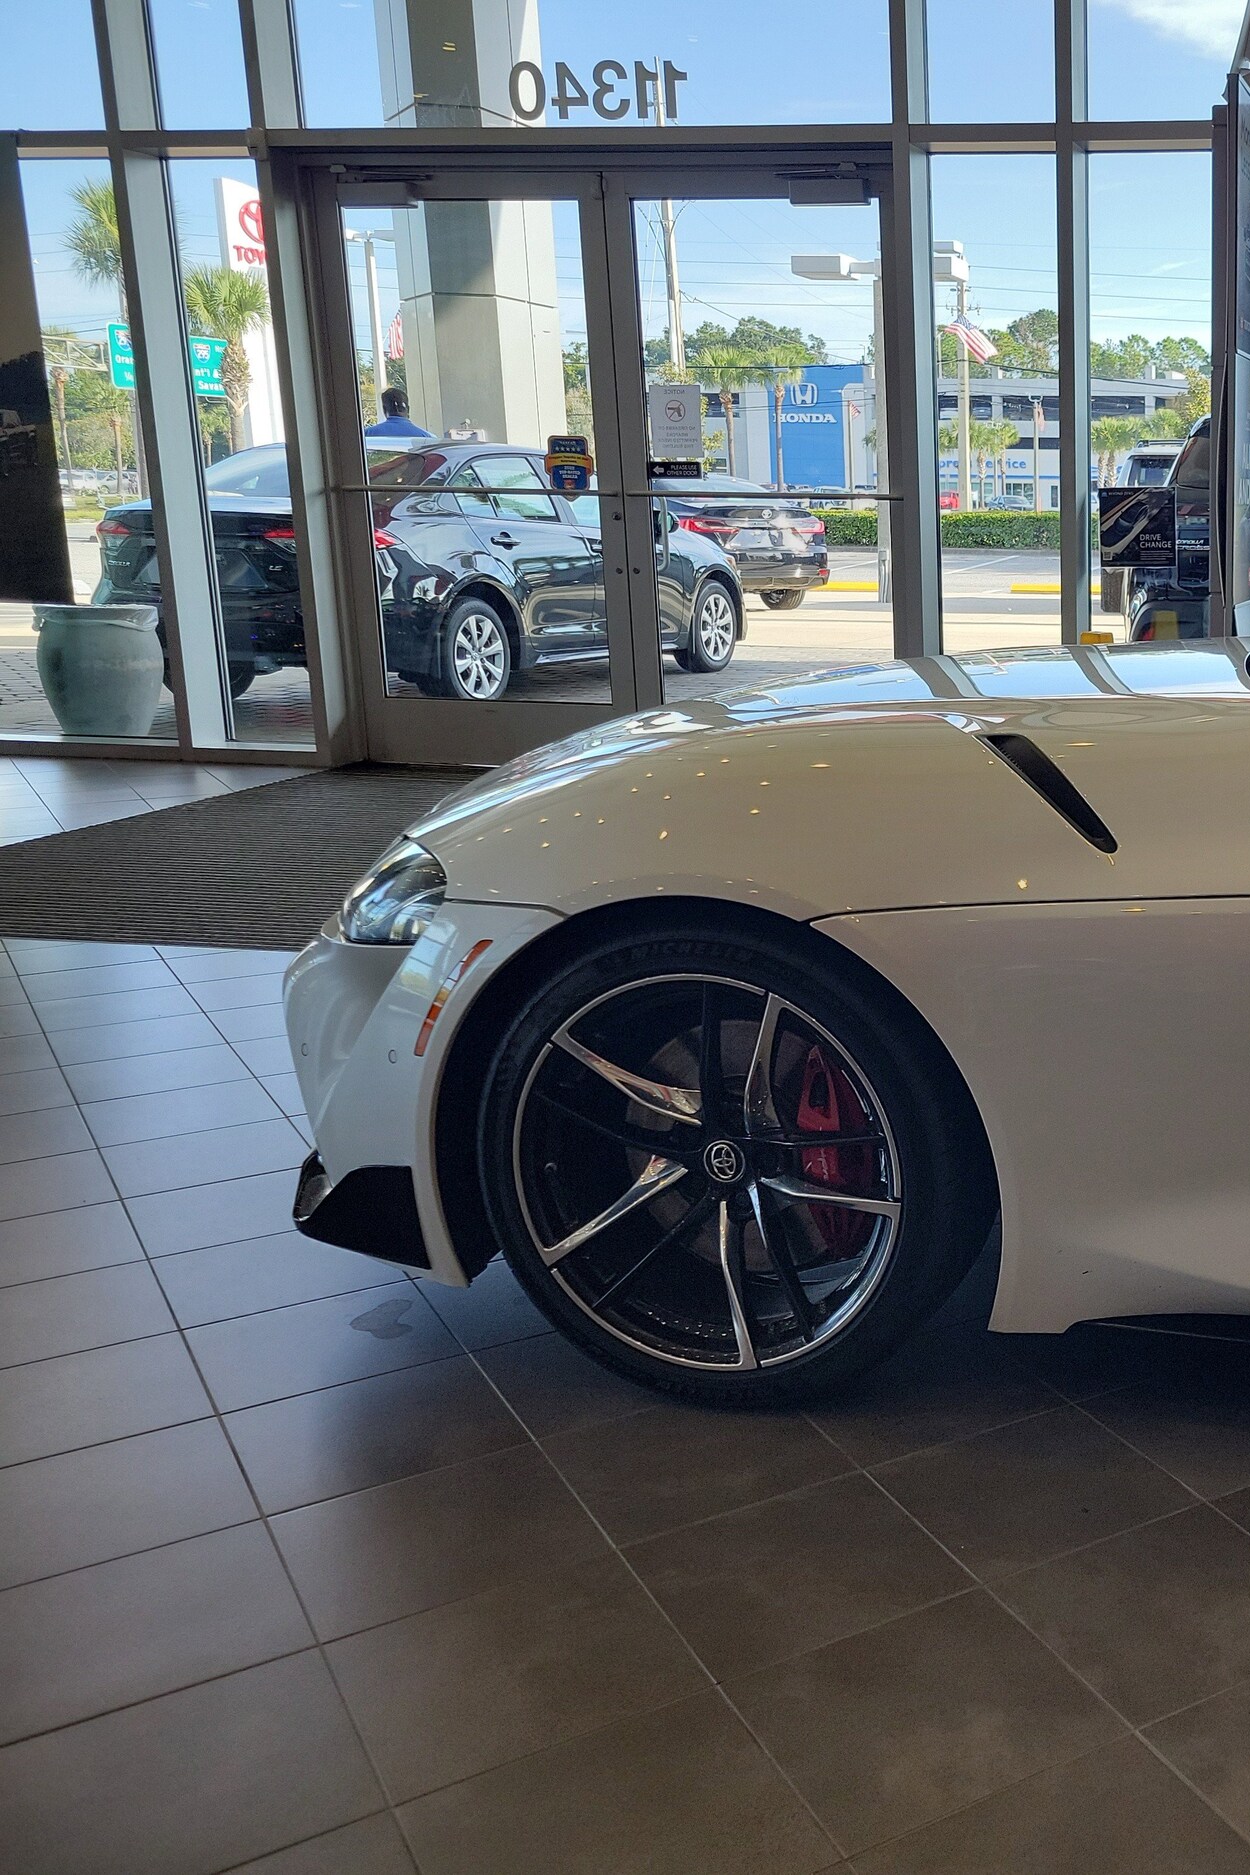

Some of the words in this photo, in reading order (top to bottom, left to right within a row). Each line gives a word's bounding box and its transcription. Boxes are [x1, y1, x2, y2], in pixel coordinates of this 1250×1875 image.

[232, 245, 266, 266] TOY
[195, 369, 210, 378] nt'l
[198, 381, 225, 391] Savan
[773, 413, 838, 423] HONDA
[1140, 541, 1172, 549] CHANGE
